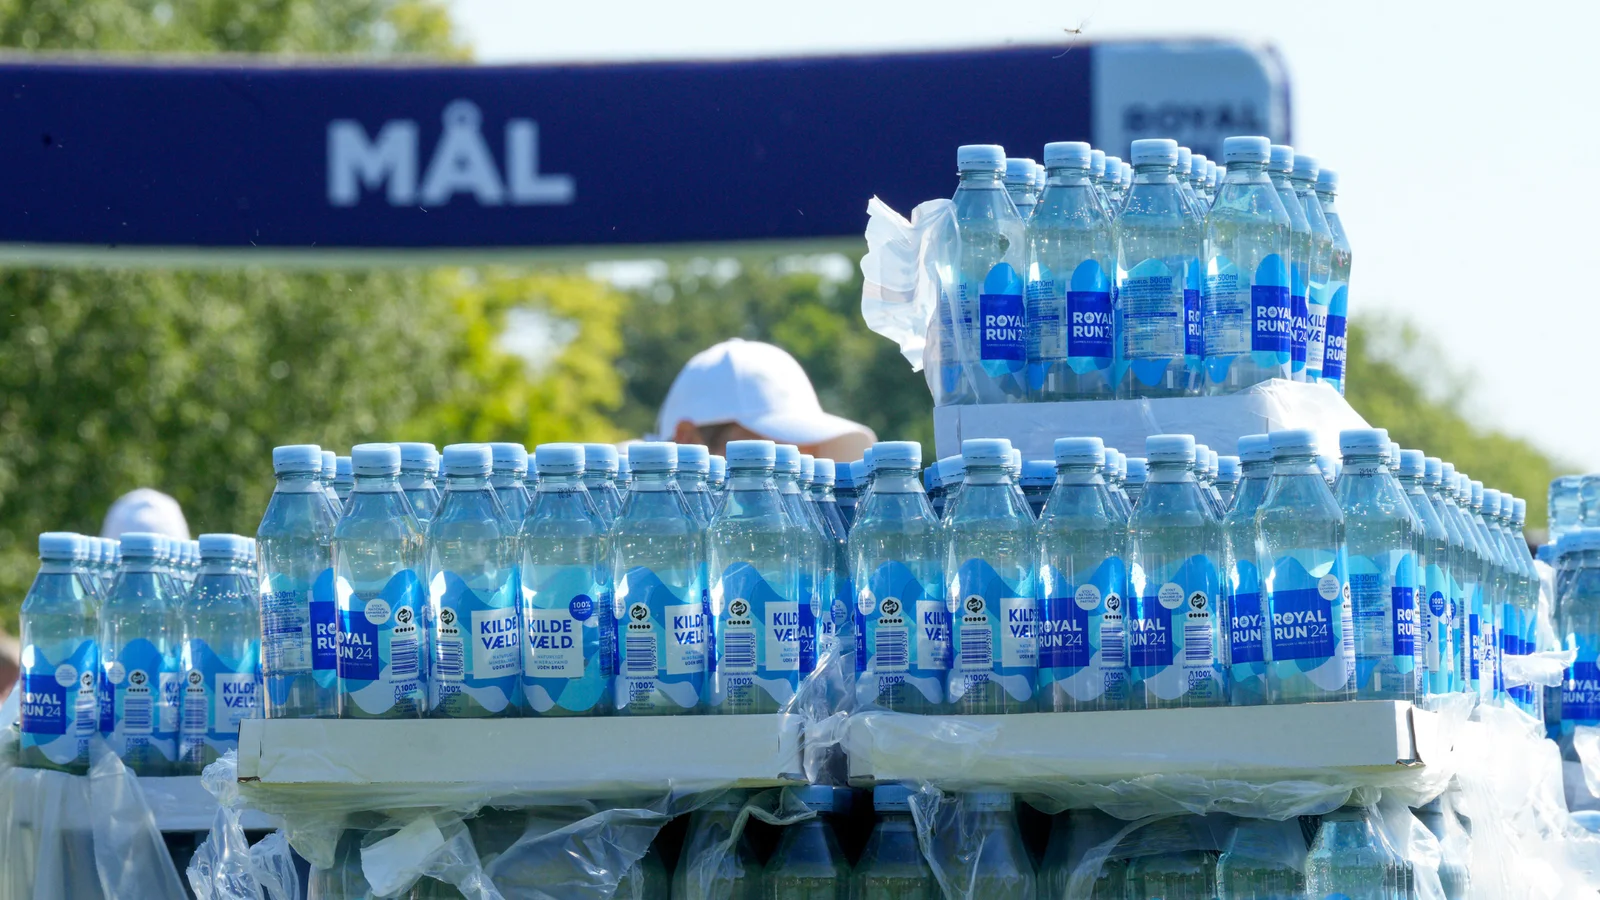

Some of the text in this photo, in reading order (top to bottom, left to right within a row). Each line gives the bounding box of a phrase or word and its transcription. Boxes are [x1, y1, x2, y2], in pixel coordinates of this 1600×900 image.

[327, 97, 577, 206] MÅL
[986, 314, 1026, 328] ROYAL
[1072, 311, 1113, 325] ROYAL
[1290, 314, 1307, 329] YAL
[1072, 325, 1104, 338] RUN
[1257, 319, 1285, 333] RUN
[986, 328, 1017, 341] RUN
[1326, 348, 1342, 361] RU
[1355, 574, 1379, 583] 500ml
[572, 601, 591, 609] 100%
[773, 612, 799, 626] KILD
[924, 611, 942, 625] KIL
[1009, 608, 1035, 623] KILD
[1231, 614, 1262, 630] ROY
[1273, 610, 1327, 627] ROYAL
[480, 616, 517, 635] KILDE
[527, 619, 572, 633] KILDE
[1039, 619, 1083, 634] ROYAL
[1274, 625, 1308, 640] RUN
[1396, 623, 1414, 636] RU
[338, 630, 373, 646] OYAL
[481, 632, 518, 650] VÆLD
[774, 628, 799, 642] VÆL
[924, 627, 942, 641] VÆ
[1039, 634, 1063, 648] RUN
[1232, 628, 1262, 644] RUN
[317, 637, 336, 650] RU
[529, 635, 575, 649] VÆLD.
[338, 646, 354, 659] UN
[733, 677, 753, 685] 100%
[885, 676, 906, 684] 100%
[969, 674, 990, 682] 100%
[1110, 672, 1125, 680] 100%
[1195, 670, 1211, 678] 100%
[401, 683, 418, 692] 100%
[443, 684, 461, 693] 100%
[635, 681, 655, 689] 100%
[1563, 692, 1585, 703] RUN
